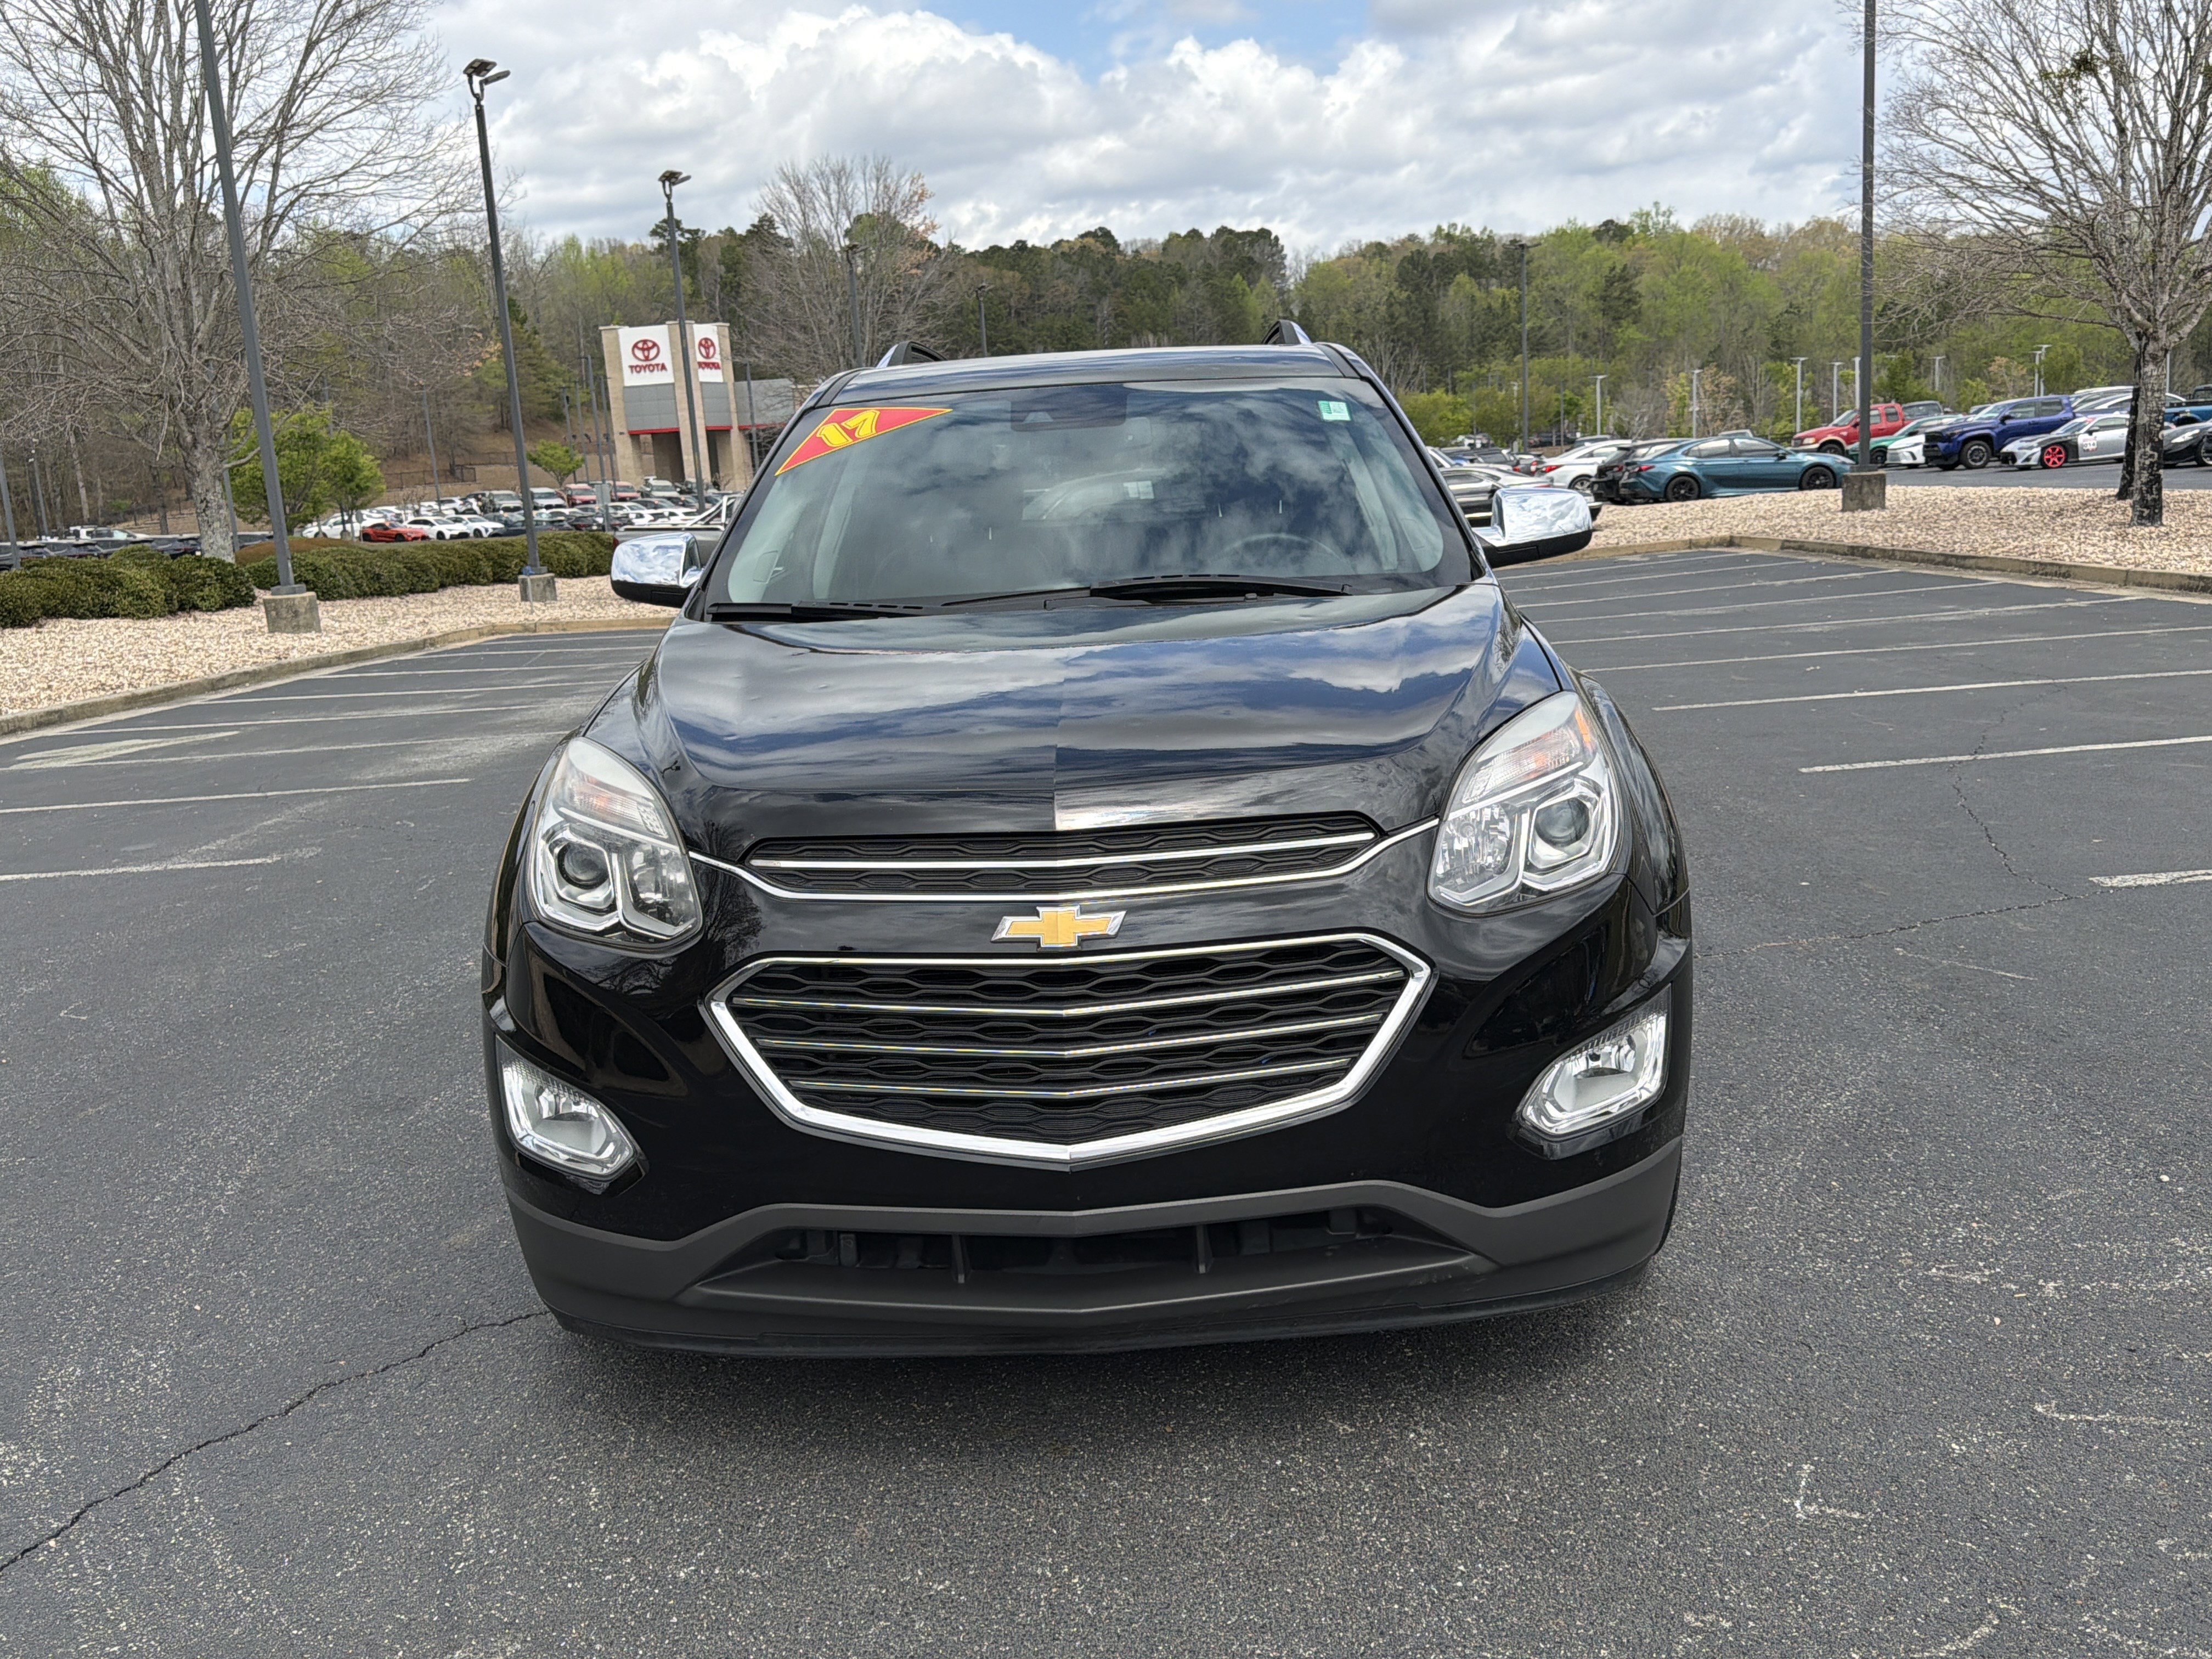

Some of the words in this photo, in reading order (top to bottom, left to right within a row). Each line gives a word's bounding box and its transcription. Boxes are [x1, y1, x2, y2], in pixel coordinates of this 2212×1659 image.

[629, 363, 668, 374] TOYOTA
[697, 361, 721, 370] TOYOTA
[816, 409, 881, 448] 17
